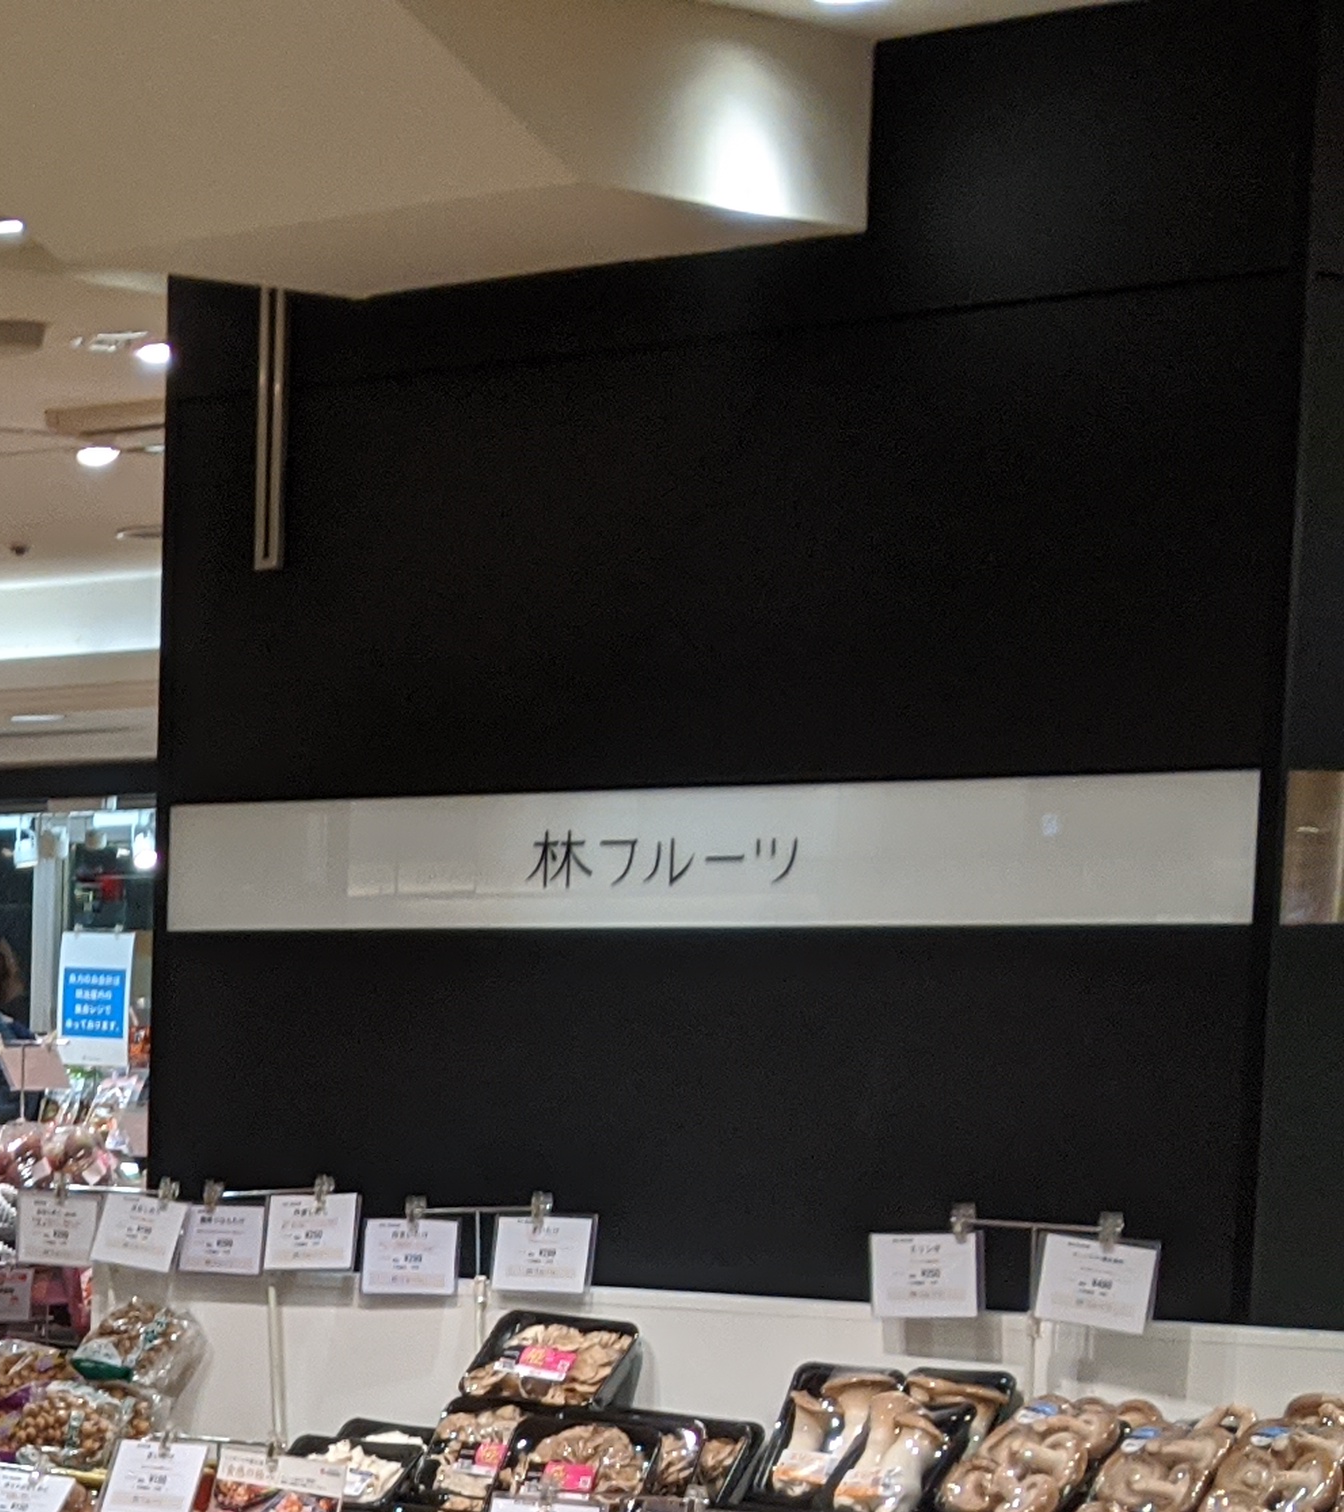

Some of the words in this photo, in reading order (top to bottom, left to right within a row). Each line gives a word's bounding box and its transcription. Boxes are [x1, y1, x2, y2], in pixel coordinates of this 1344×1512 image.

[525, 829, 799, 889] 林フルーツ
